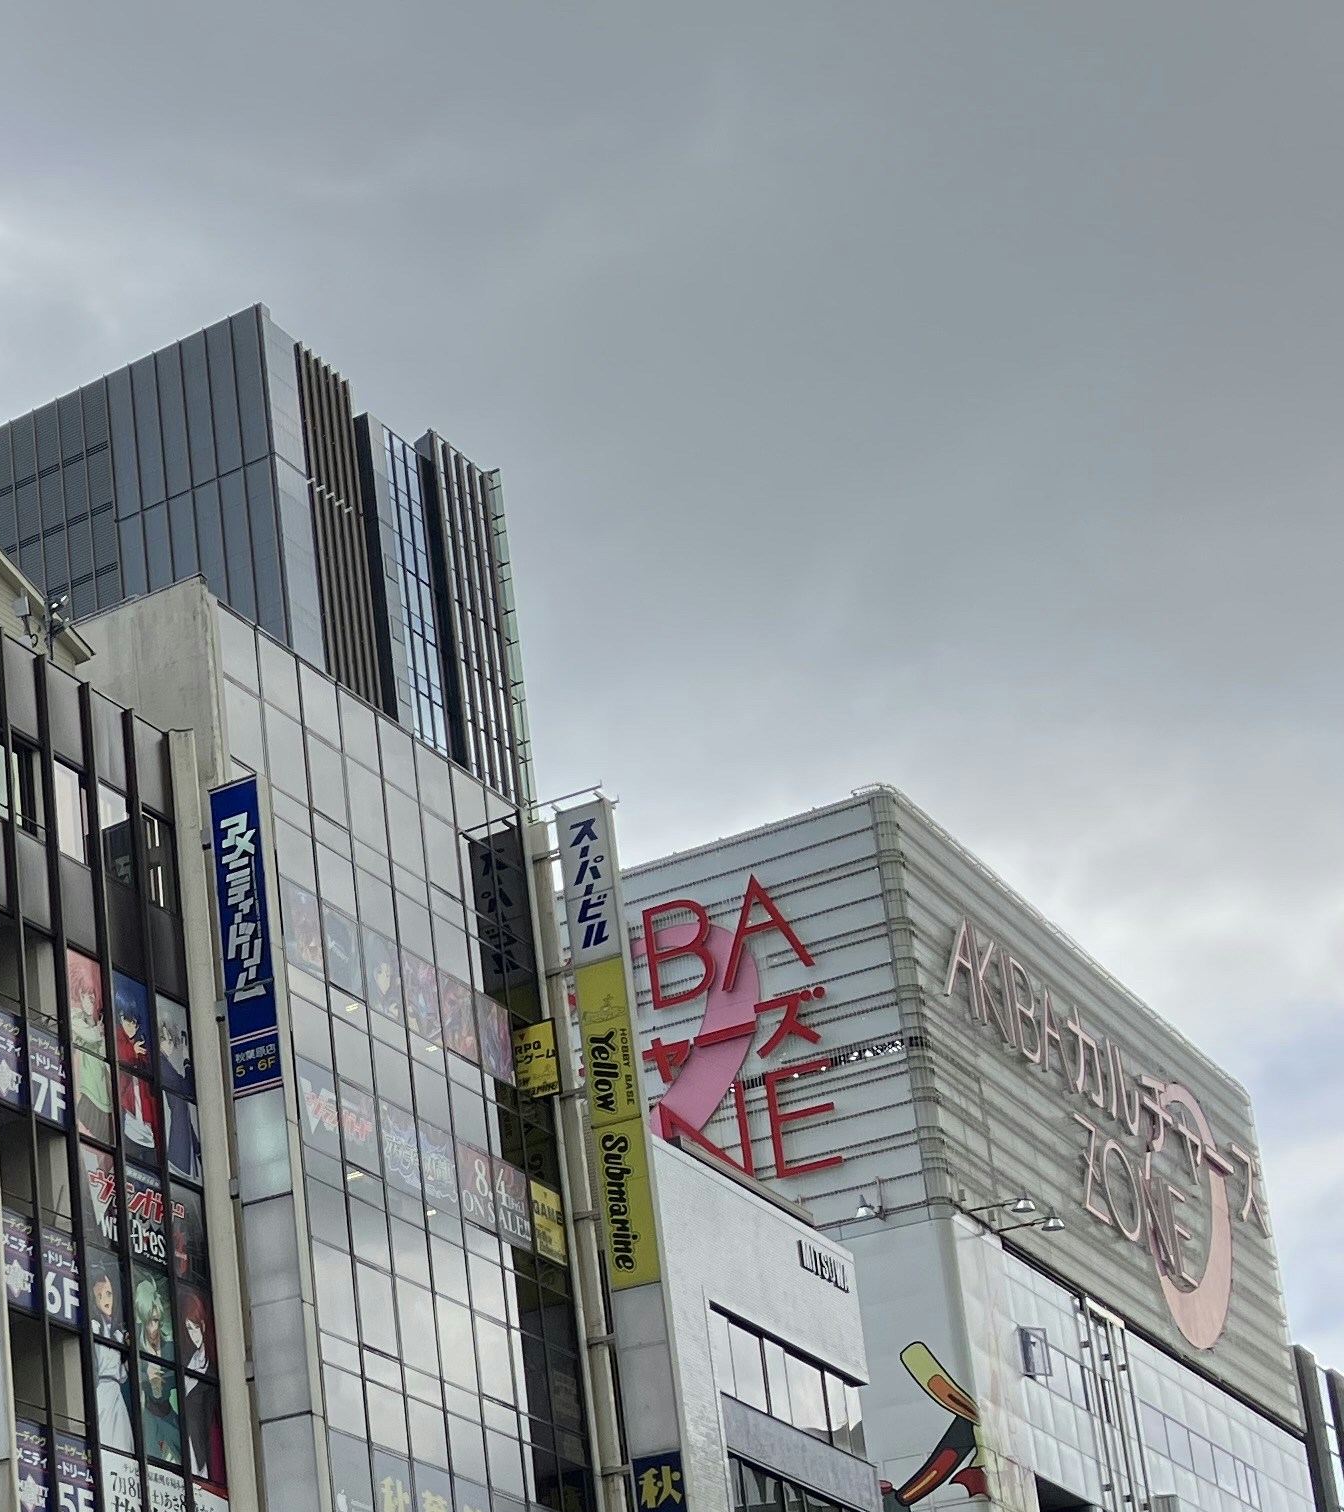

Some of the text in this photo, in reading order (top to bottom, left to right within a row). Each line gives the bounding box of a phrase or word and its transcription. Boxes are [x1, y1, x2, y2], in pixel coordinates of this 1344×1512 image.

[569, 818, 609, 949] スーパービル
[31, 1071, 66, 1121] 7F
[589, 1029, 637, 1274] Yellow Submarine
[44, 1270, 80, 1321] 6F
